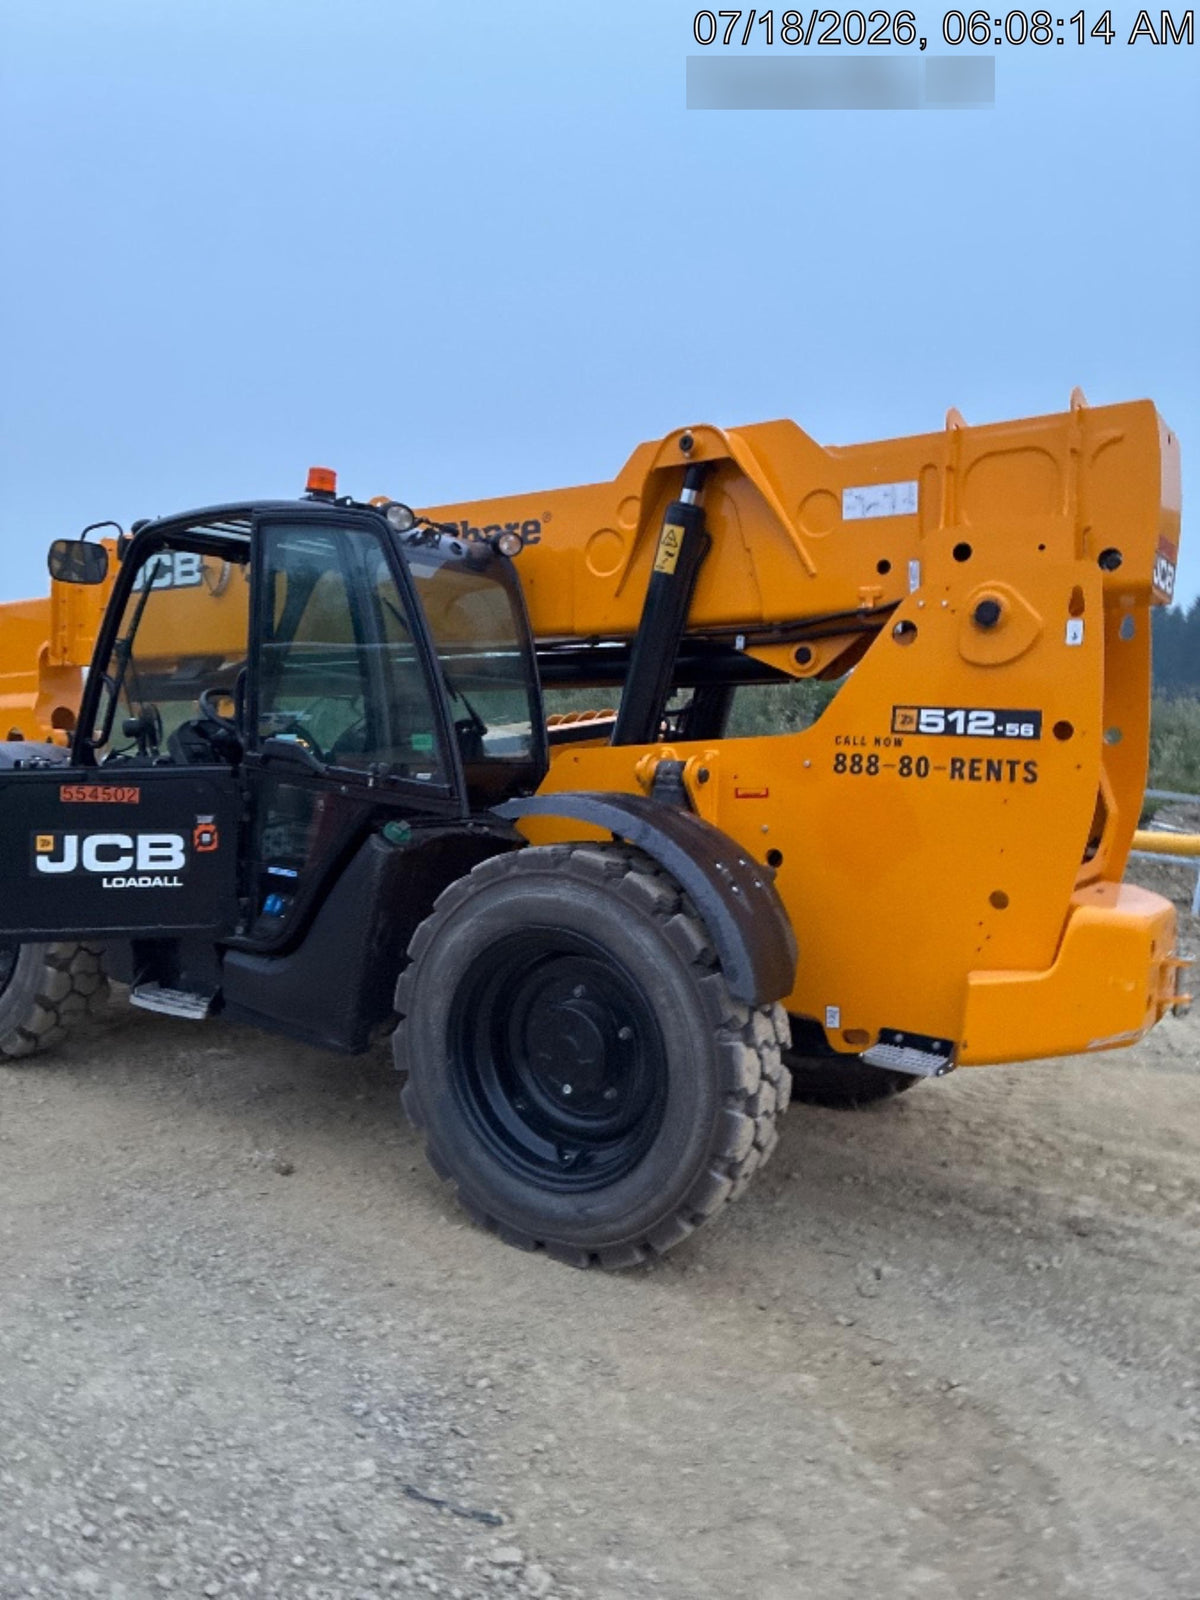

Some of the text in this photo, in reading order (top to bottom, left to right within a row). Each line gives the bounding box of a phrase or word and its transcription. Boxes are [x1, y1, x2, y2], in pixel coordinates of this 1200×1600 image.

[835, 735, 904, 748] CALL NOW
[833, 753, 1038, 784] 888-80-RENTS
[62, 785, 138, 803] 554502
[36, 833, 186, 874] JCB
[102, 876, 184, 889] LOADALL
